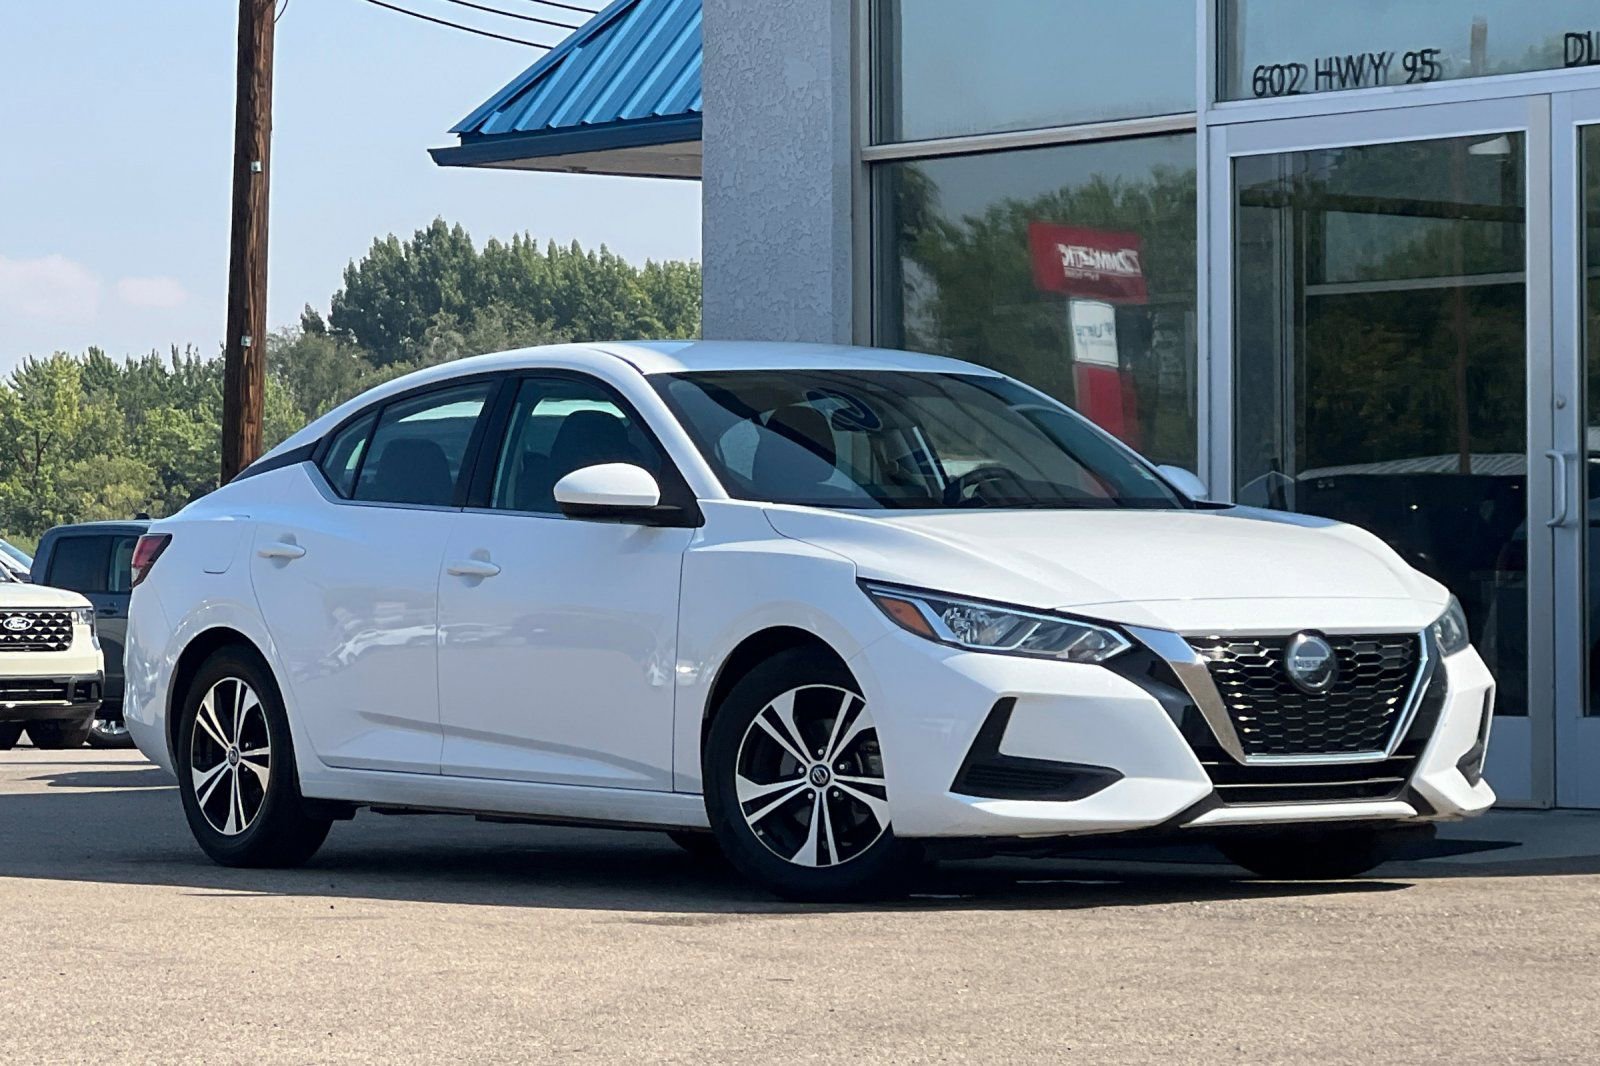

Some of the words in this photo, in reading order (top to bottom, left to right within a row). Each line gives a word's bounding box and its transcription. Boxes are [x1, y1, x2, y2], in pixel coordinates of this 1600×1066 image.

[1253, 62, 1307, 96] 602
[1315, 52, 1389, 91] HWY
[1402, 49, 1442, 84] 95
[1294, 659, 1326, 669] NISS
